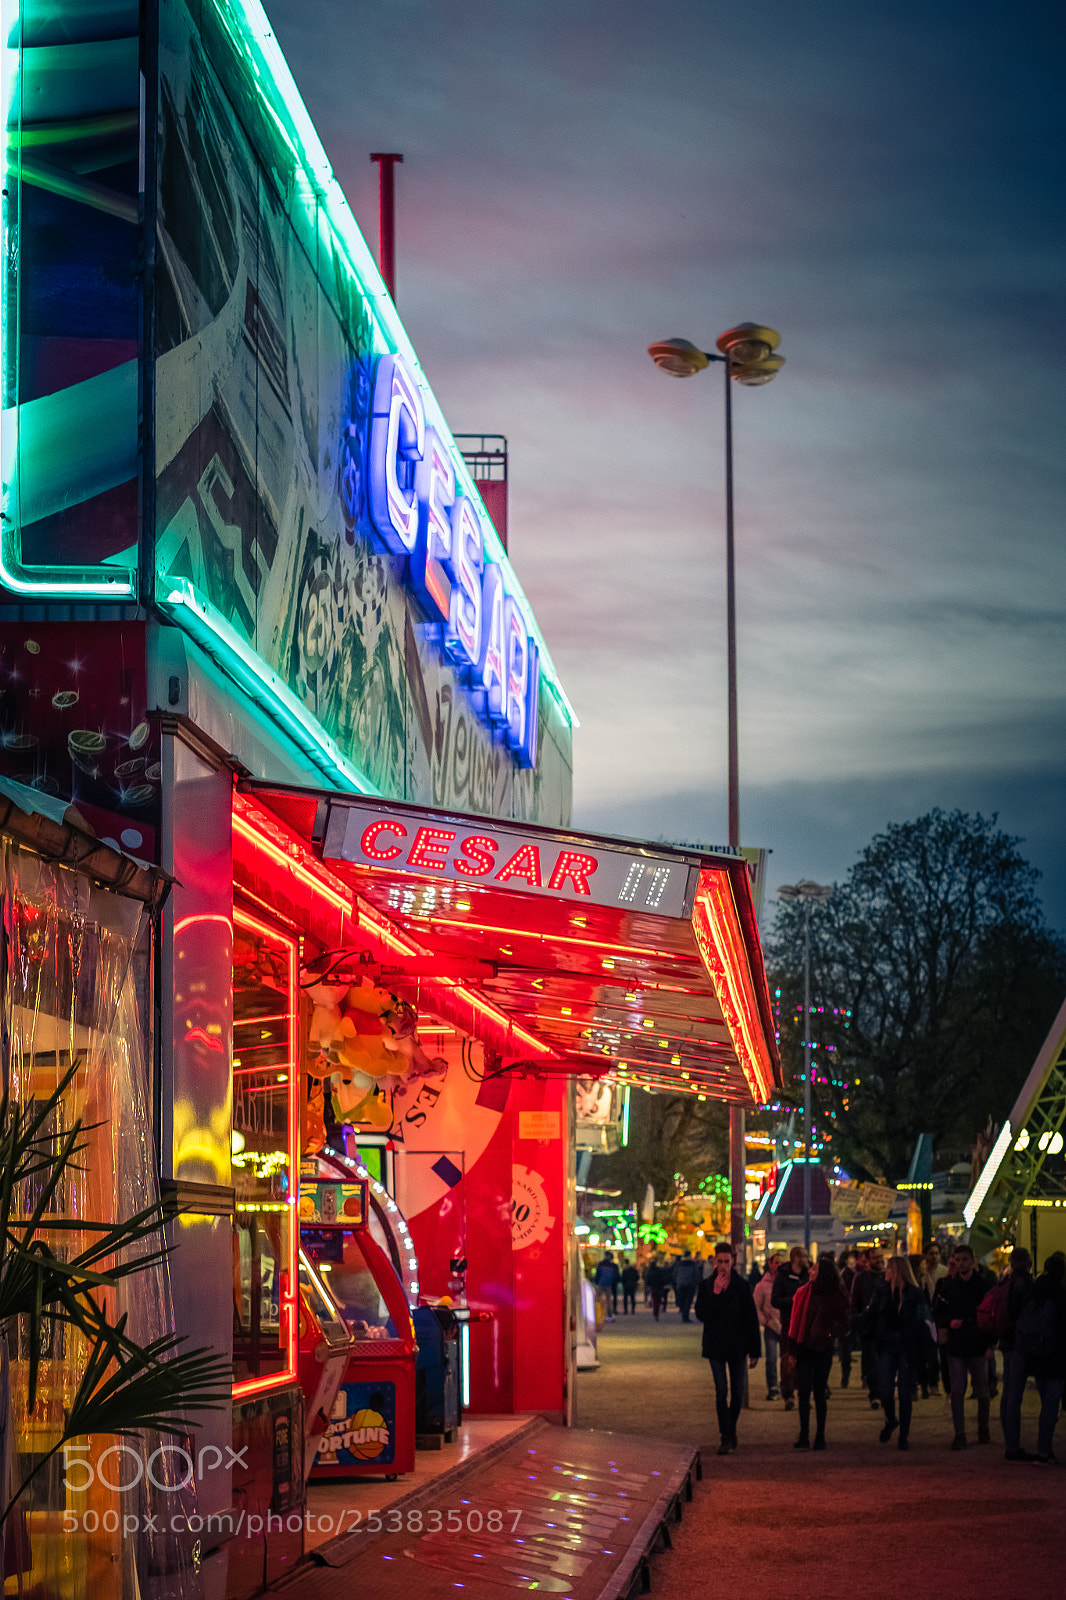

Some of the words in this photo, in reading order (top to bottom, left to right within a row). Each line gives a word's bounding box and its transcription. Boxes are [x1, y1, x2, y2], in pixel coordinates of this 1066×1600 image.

[367, 353, 528, 750] CESAR
[360, 820, 599, 895] CESAR
[318, 1427, 390, 1453] ORTUNE
